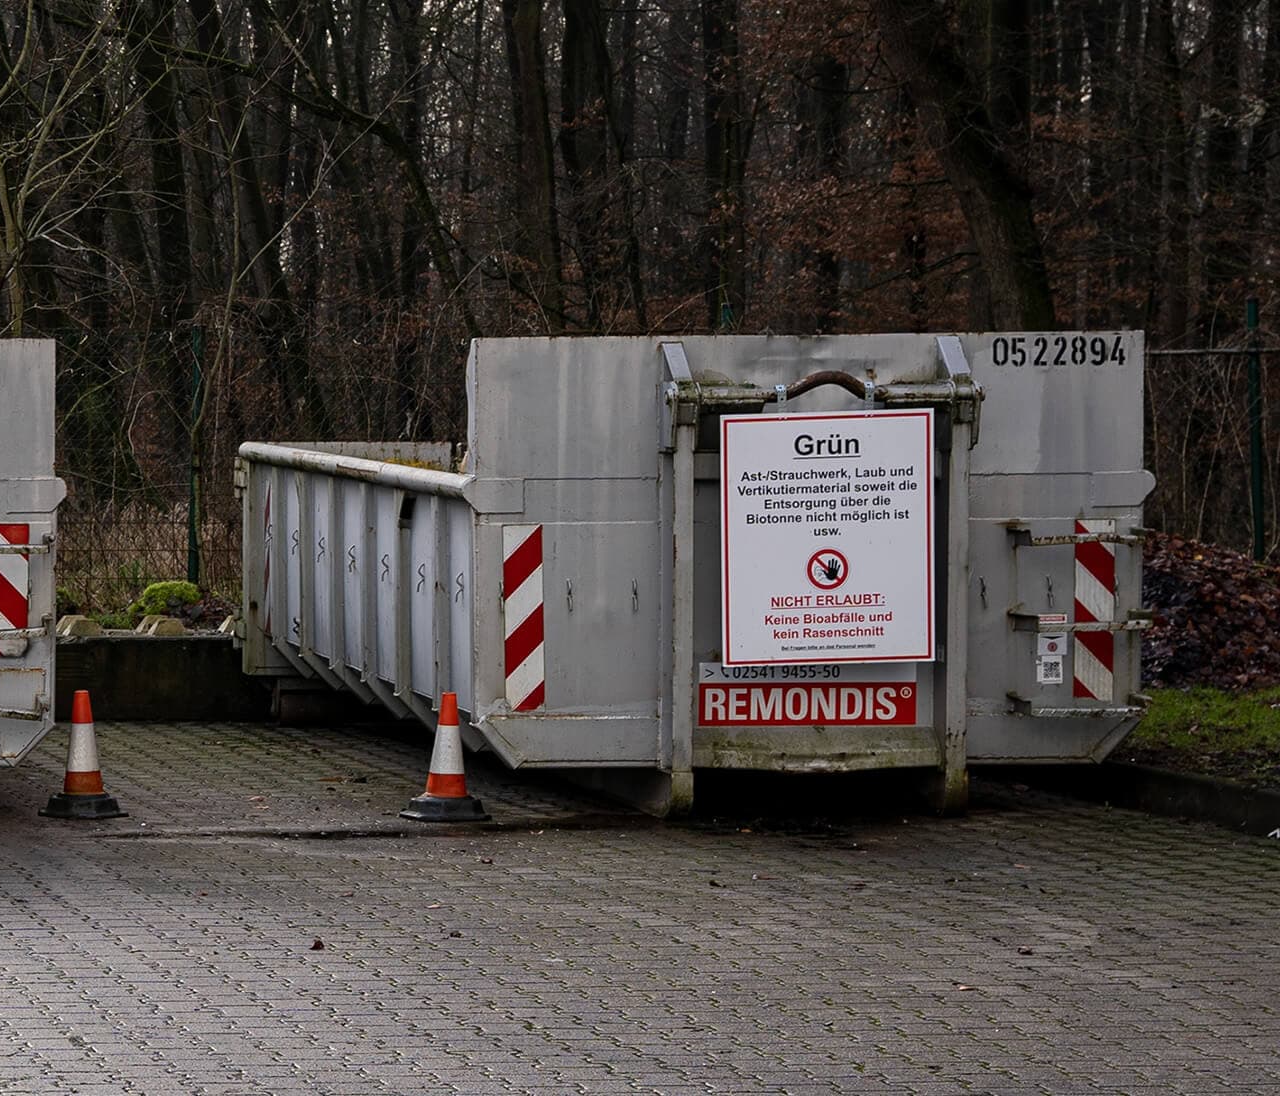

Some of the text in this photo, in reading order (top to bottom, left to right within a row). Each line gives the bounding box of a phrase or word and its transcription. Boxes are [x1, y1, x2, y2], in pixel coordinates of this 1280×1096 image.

[992, 336, 1126, 366] 0522894
[794, 434, 860, 456] Grün
[741, 466, 914, 483] Ast-/Strauchwerk, Laub und
[737, 480, 918, 496] Vertikutiermaterial soweit die
[764, 495, 891, 511] Entsorgung über die
[746, 509, 910, 525] Biotonne nicht möglich ist
[813, 527, 842, 537] usw.
[771, 593, 886, 608] NICHT ERLAUBT:
[764, 611, 893, 626] Keine Bioabfälle und
[773, 626, 884, 640] kein Rasenschnitt
[732, 665, 840, 679] 02541 9455-50
